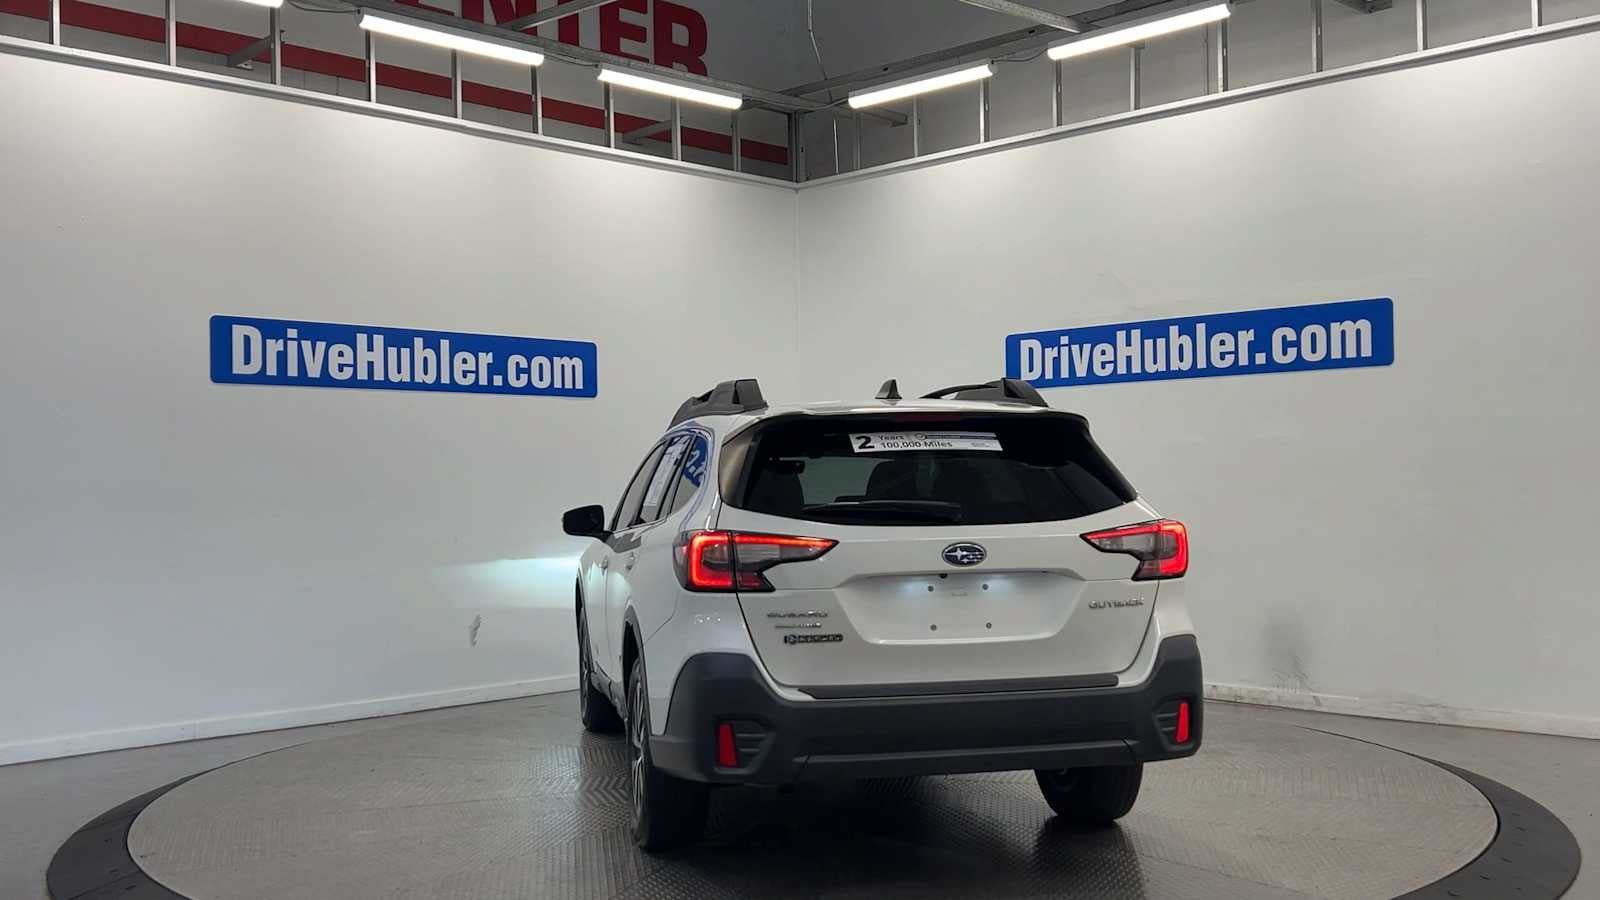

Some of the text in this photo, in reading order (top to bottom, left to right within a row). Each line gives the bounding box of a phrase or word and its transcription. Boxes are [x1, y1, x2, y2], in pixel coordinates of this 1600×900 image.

[231, 323, 584, 390] DriveHubler.com
[1019, 317, 1373, 382] DriveHubler.com
[855, 435, 875, 450] 2
[924, 440, 953, 448] Miles
